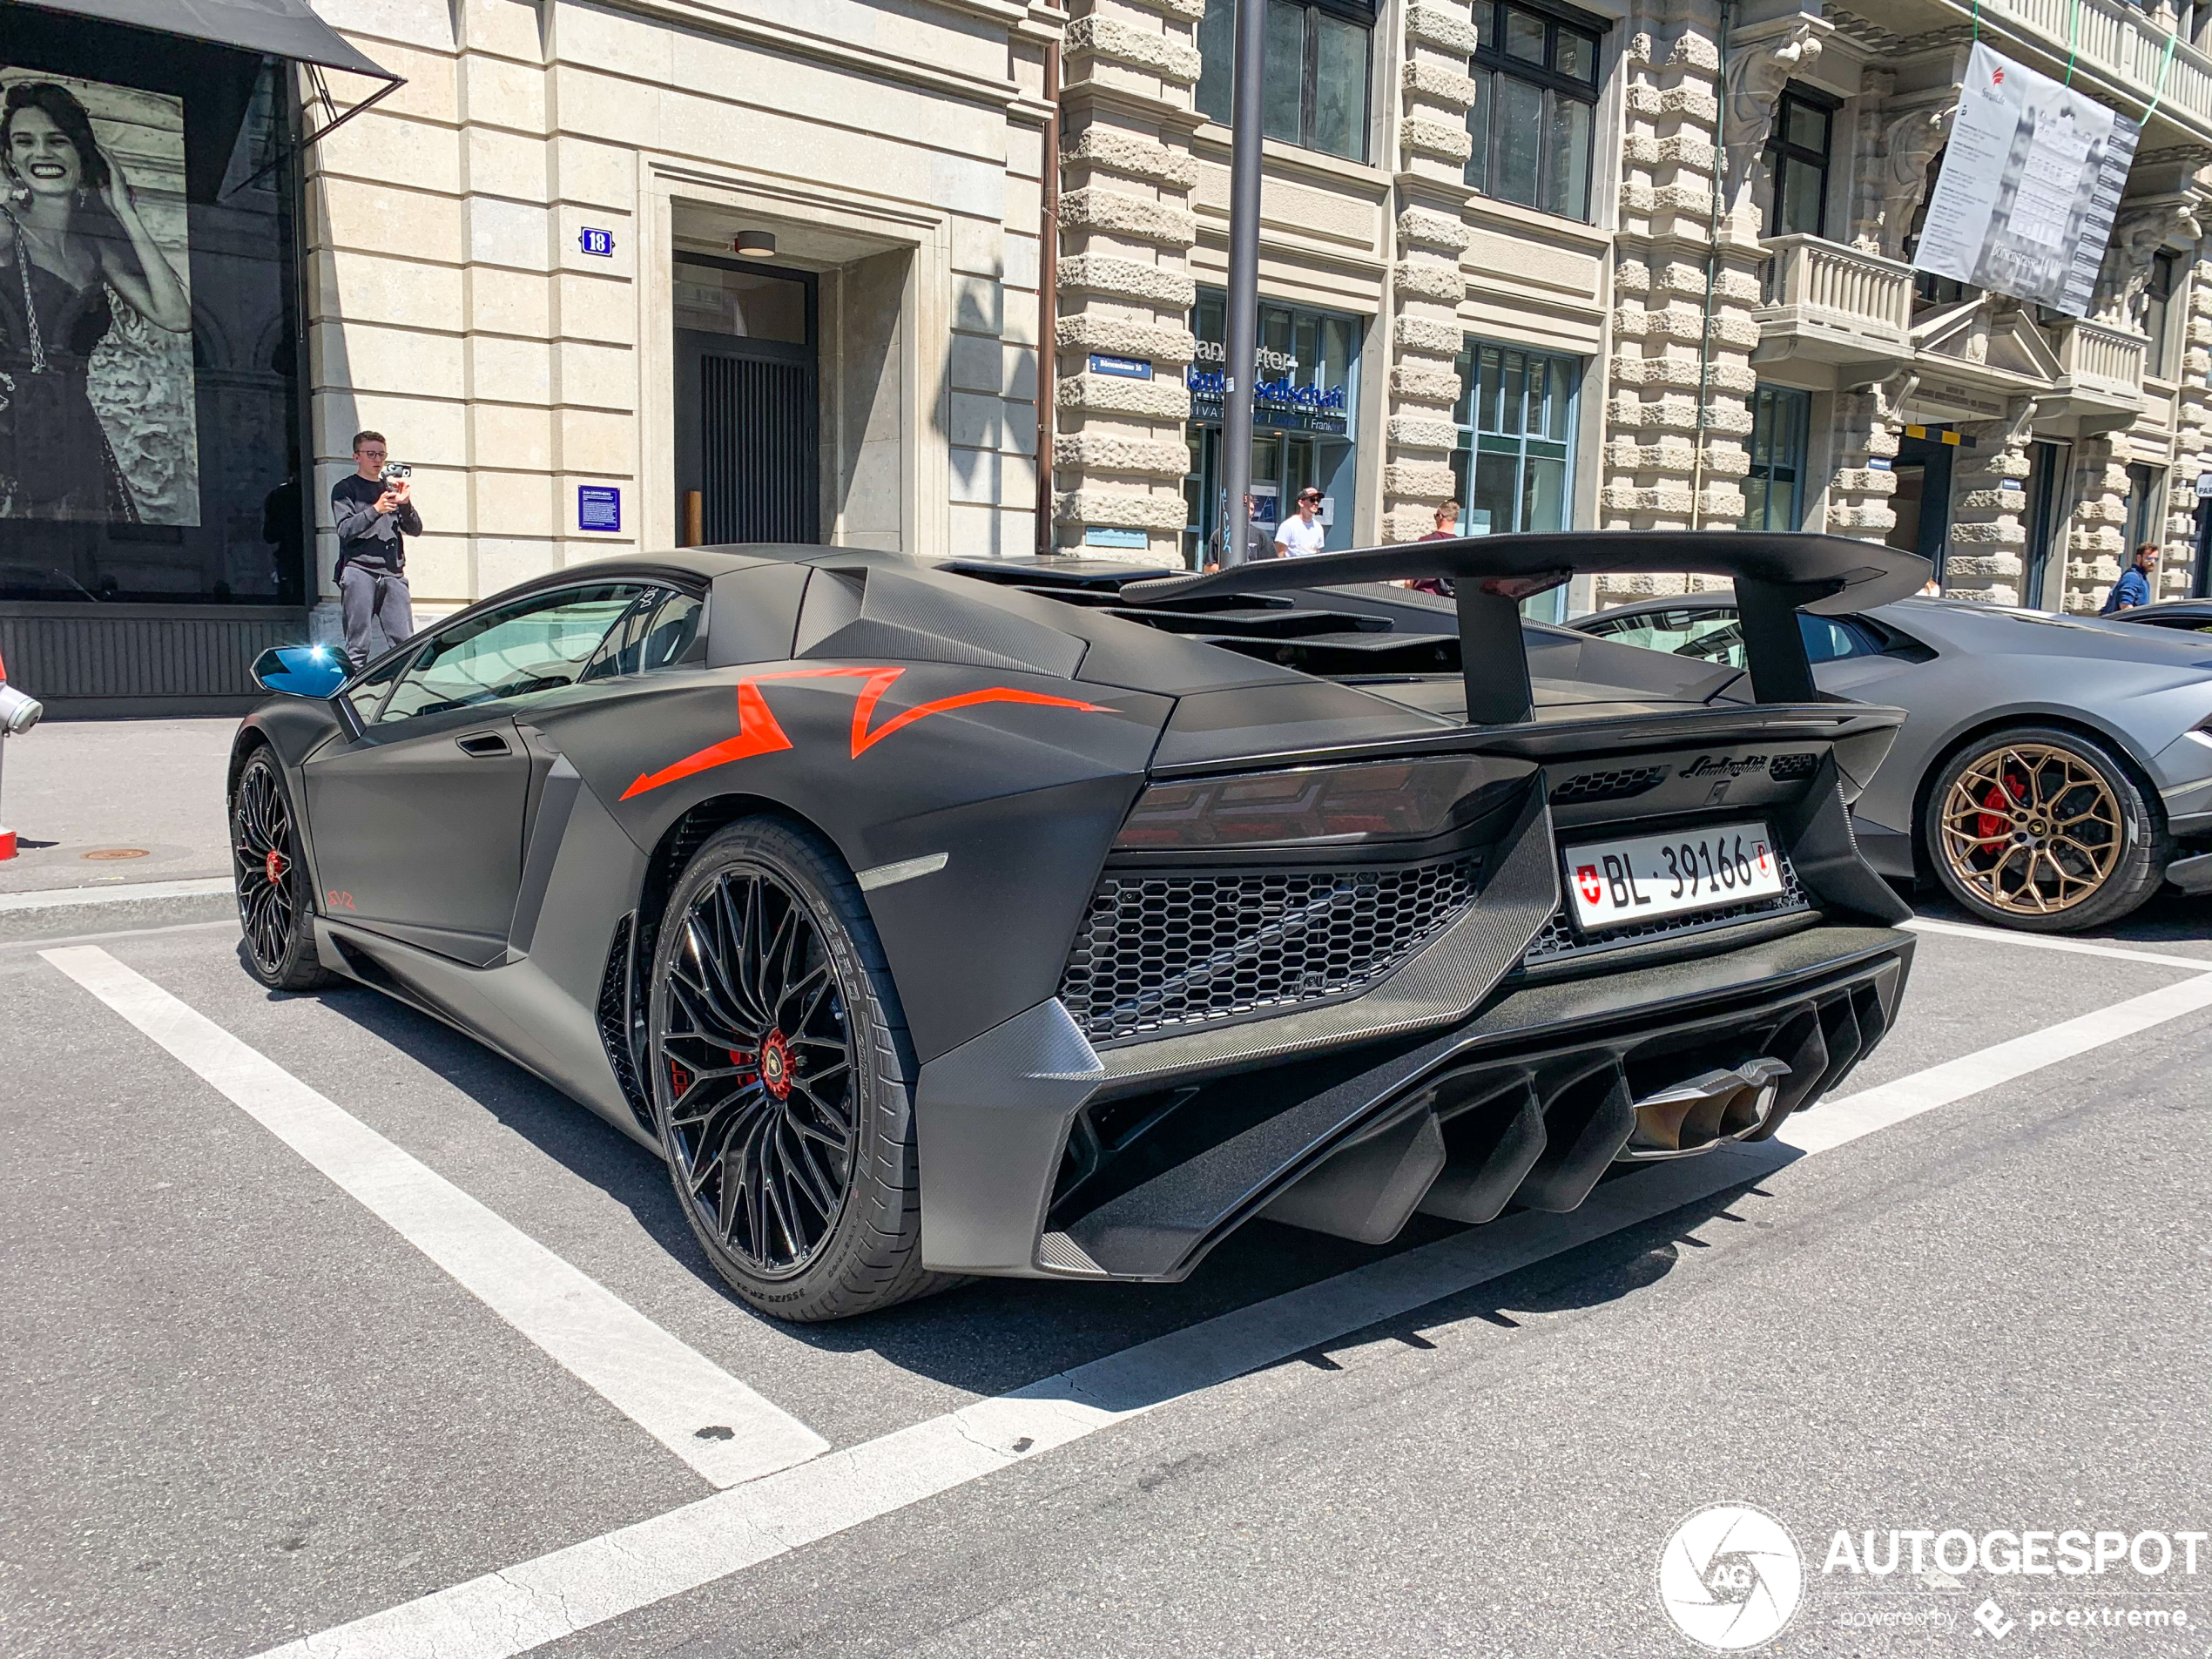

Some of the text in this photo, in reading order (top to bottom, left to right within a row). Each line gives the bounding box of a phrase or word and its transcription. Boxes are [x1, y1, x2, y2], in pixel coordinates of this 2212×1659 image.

[590, 233, 605, 252] 18
[1100, 360, 1134, 371] Börsenstrasse
[1311, 419, 1345, 434] Frankfurt
[1679, 754, 1768, 779] Lamborghini
[1602, 835, 1752, 908] BL 39166
